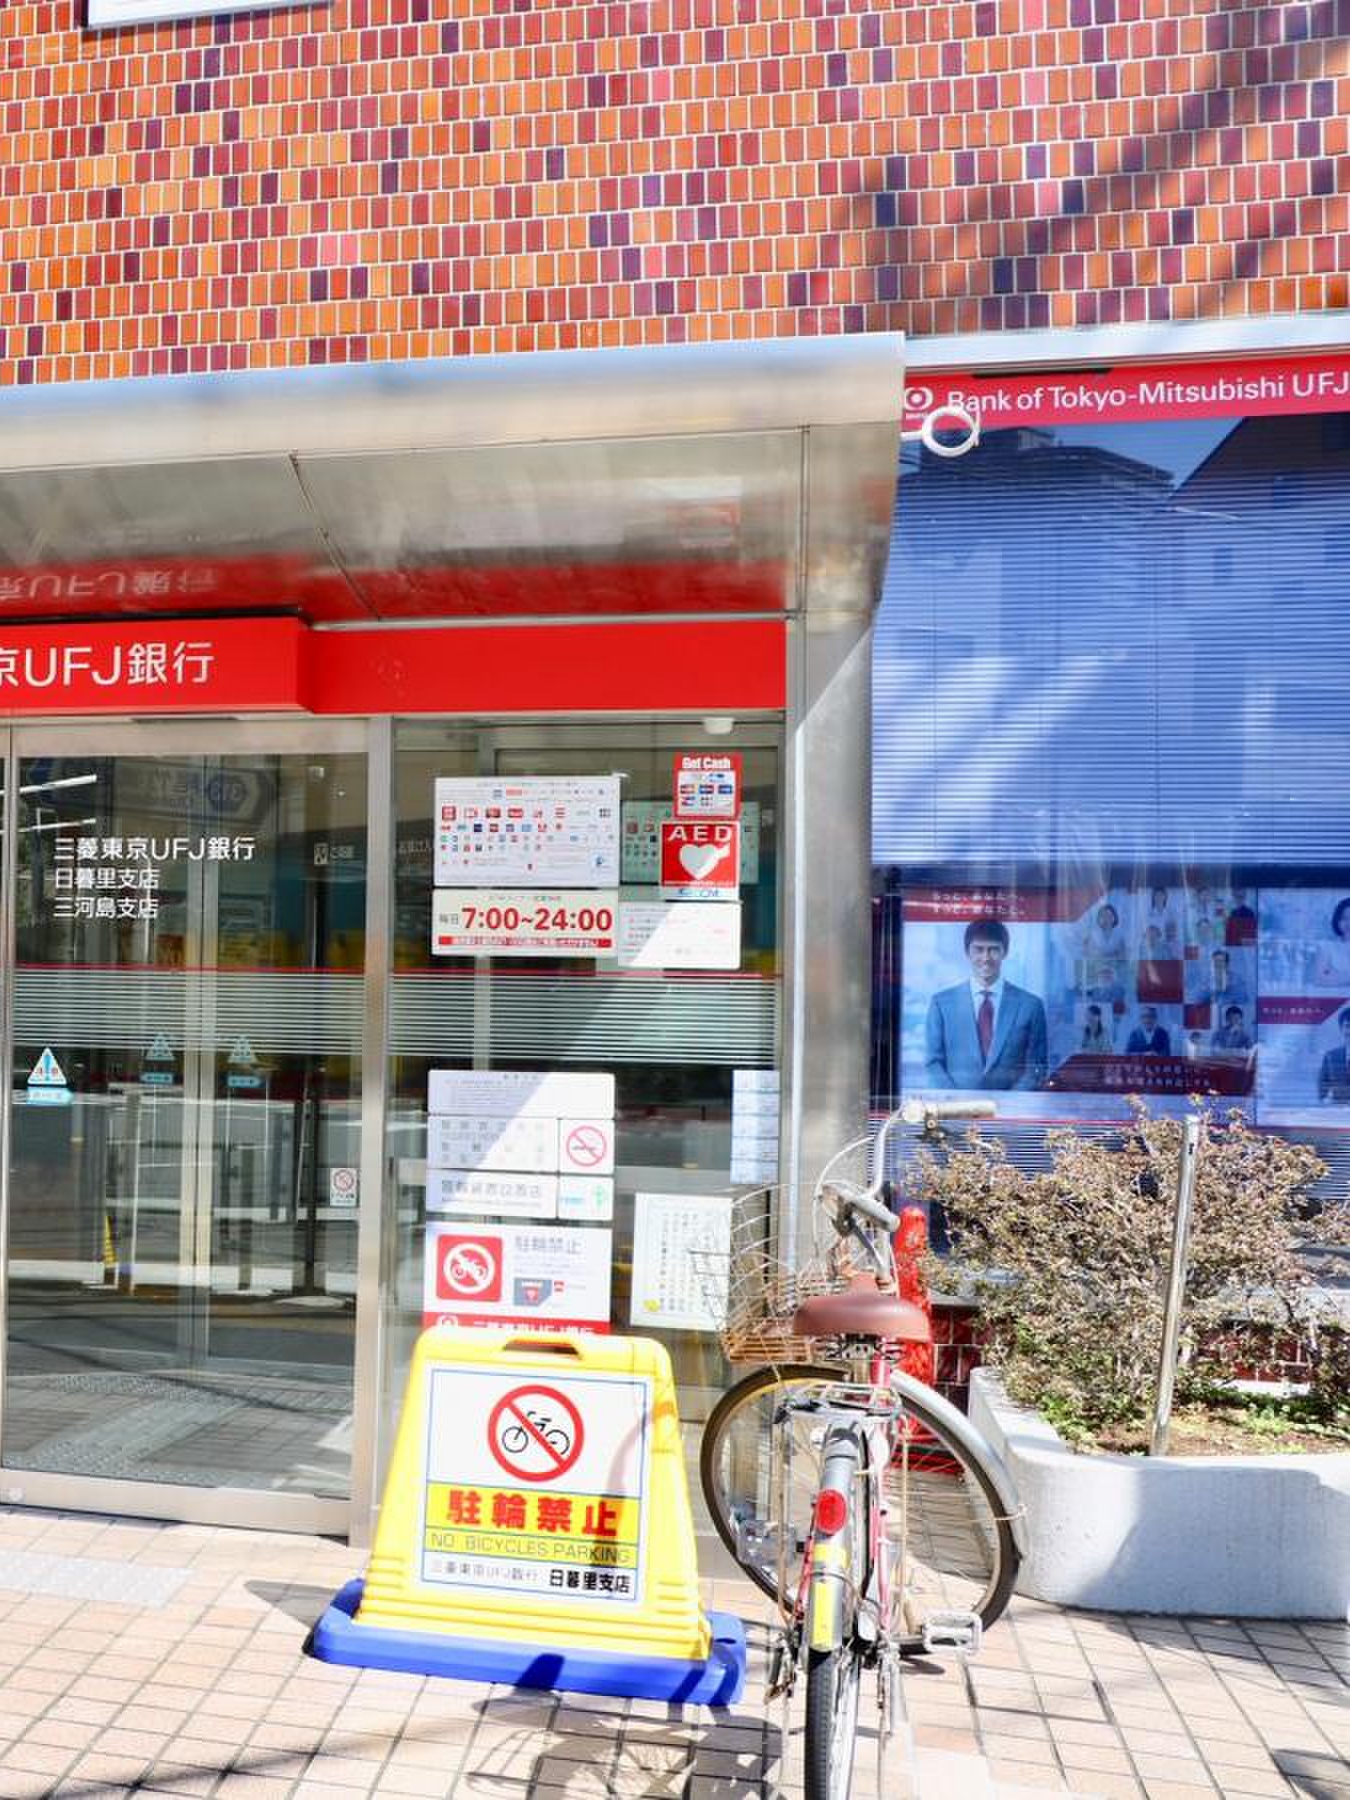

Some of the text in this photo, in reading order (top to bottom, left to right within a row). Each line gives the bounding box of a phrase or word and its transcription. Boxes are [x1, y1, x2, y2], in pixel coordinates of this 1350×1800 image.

[949, 371, 1350, 412] Bank of Tokyo-Mitsubishi UFJ
[668, 825, 732, 842] AED
[54, 836, 256, 861] 三菱東京UFJ銀行
[55, 867, 160, 890] 日暮里支店
[53, 896, 160, 920] 三河島支店
[447, 1489, 618, 1537] 駐輪禁止
[430, 1533, 631, 1564] NO BICYCLES PARKING
[549, 1568, 632, 1594] 日暮里支店
